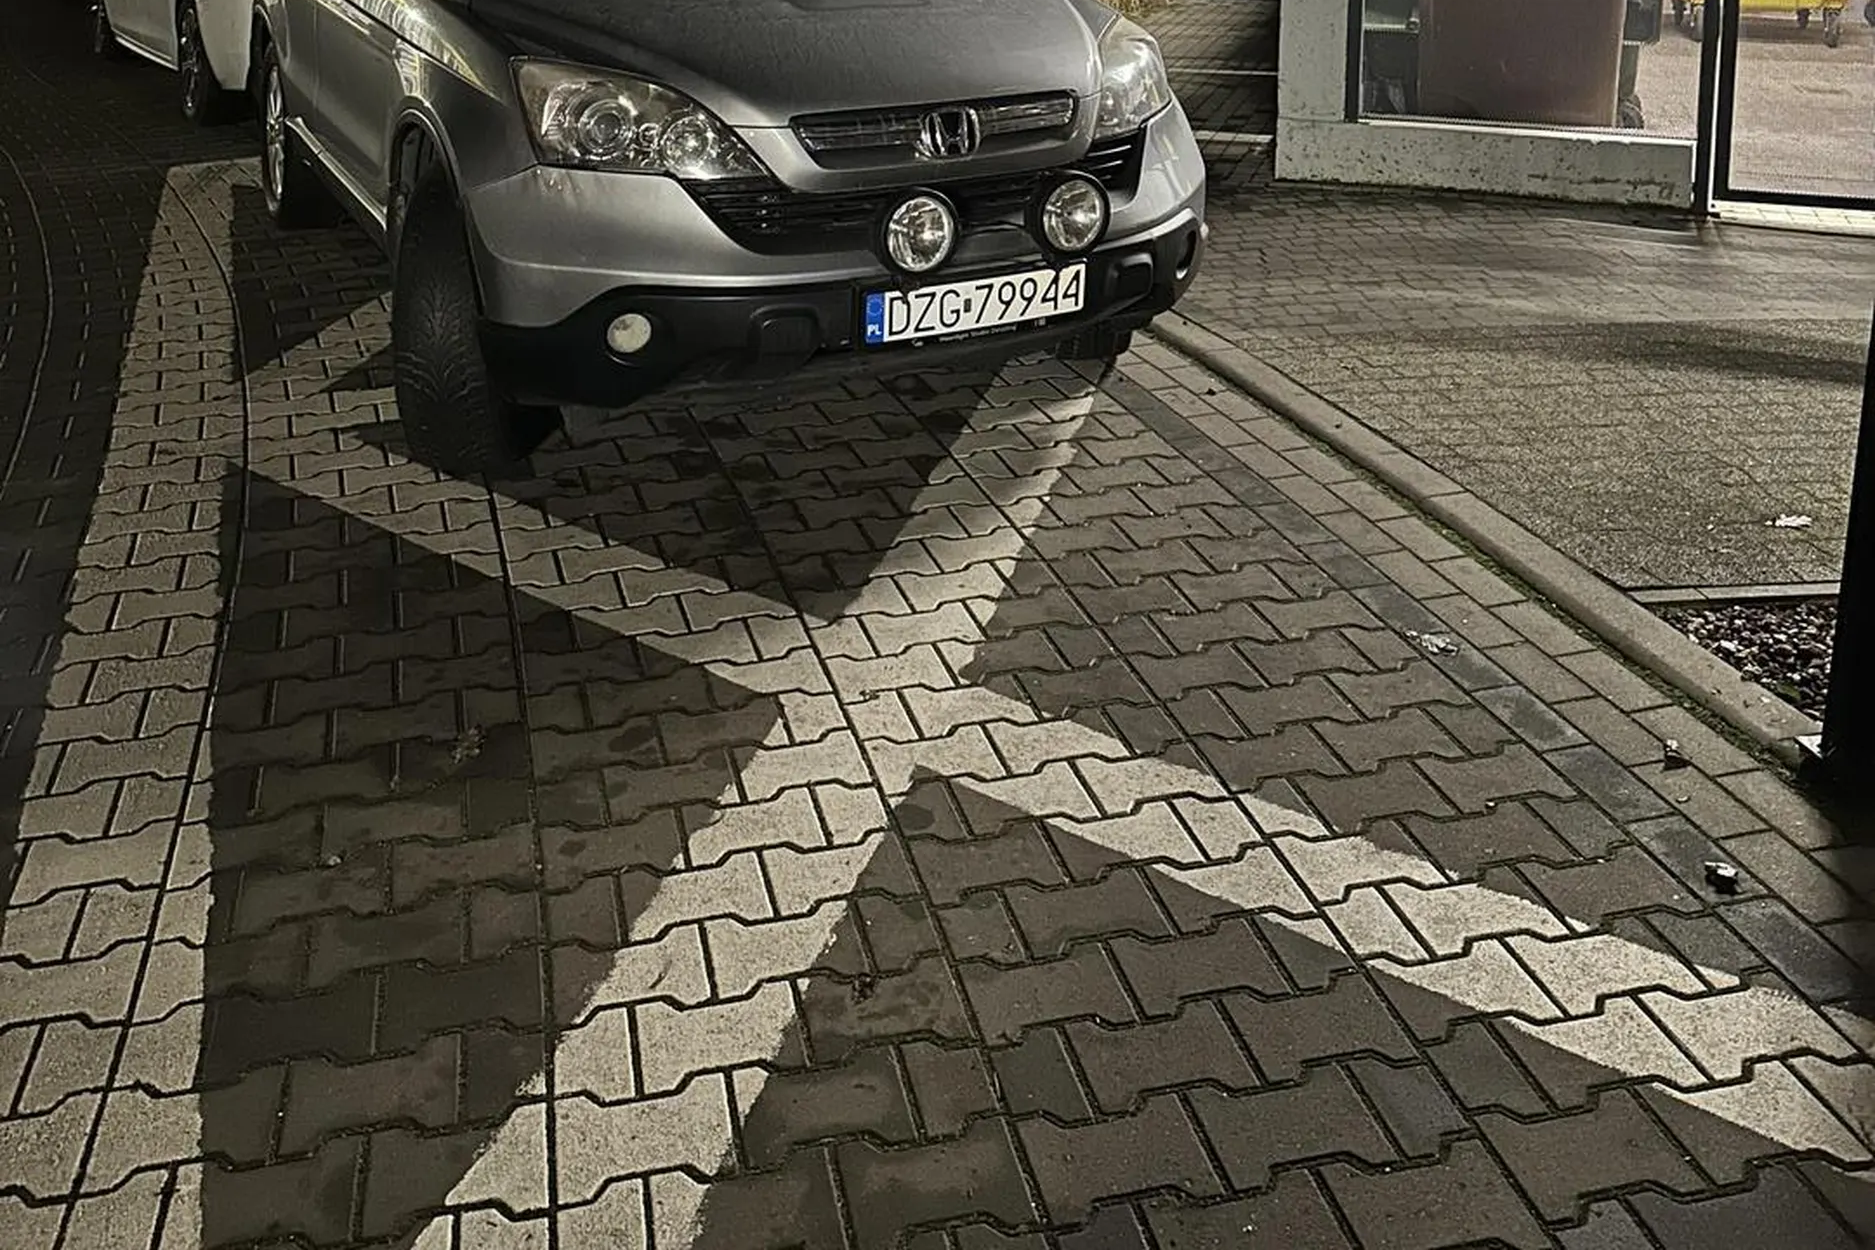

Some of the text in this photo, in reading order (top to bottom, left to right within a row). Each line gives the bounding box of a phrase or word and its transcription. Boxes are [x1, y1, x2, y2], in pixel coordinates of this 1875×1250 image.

[889, 269, 1081, 336] DZG 79944
[867, 324, 882, 336] PL
